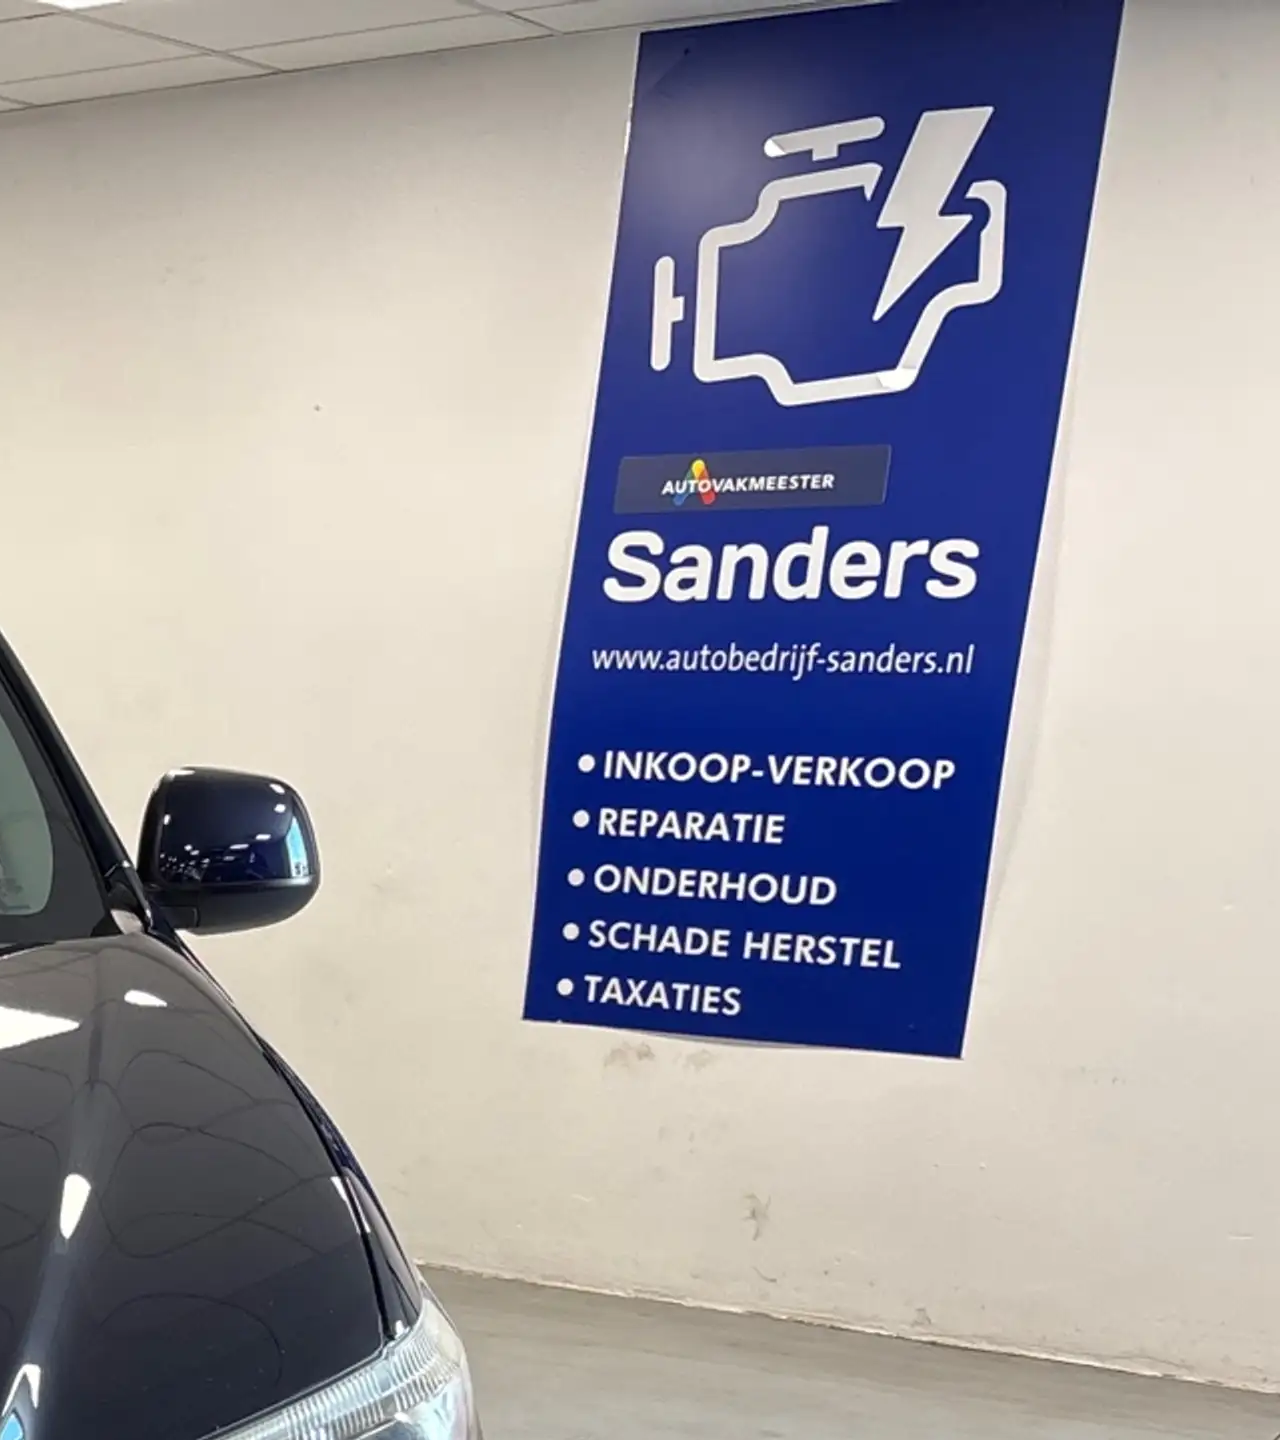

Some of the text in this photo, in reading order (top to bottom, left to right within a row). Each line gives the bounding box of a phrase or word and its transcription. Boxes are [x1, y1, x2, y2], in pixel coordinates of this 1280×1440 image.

[661, 472, 835, 496] AUTOVAKMEESTER
[602, 525, 980, 603] Sanders
[591, 642, 975, 681] www.autobedrijf-sanders.nl
[603, 750, 956, 790] INKOOP-VERKOOP
[597, 807, 785, 844] REPARATIE
[593, 864, 837, 905] ONDERHOUD
[588, 919, 901, 969] SCHADE HERSTEL
[584, 974, 741, 1016] TAXATIES
